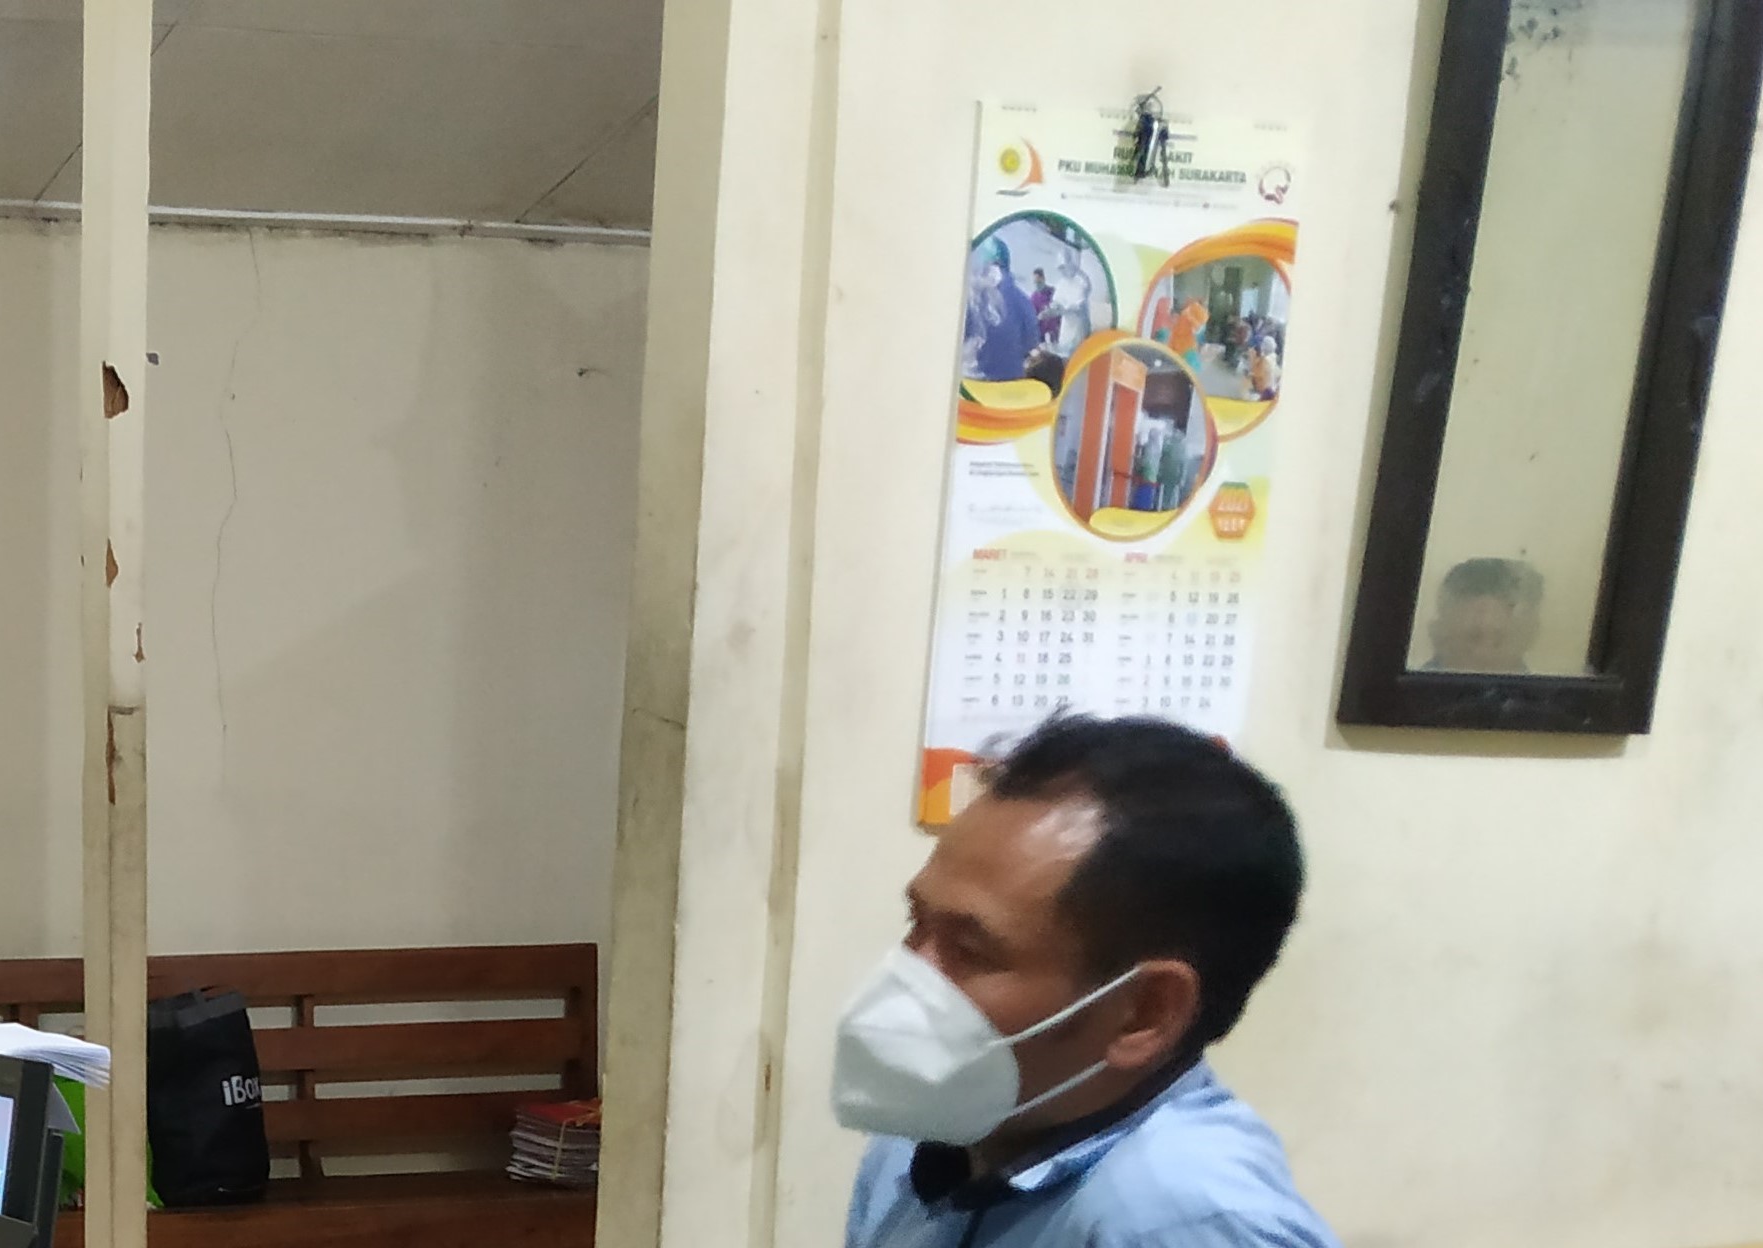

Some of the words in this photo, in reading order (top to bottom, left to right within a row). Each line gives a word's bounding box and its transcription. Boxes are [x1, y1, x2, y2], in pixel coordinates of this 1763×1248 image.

[1058, 159, 1082, 173] PKU
[1178, 167, 1247, 184] SURAKARTA
[973, 548, 1007, 561] MARET
[1042, 588, 1054, 600] 15
[1063, 589, 1076, 600] 22
[1062, 609, 1075, 622] 23
[996, 630, 1004, 641] 3
[1017, 630, 1030, 642] 10
[1039, 631, 1051, 643] 17
[1014, 673, 1026, 685] 12
